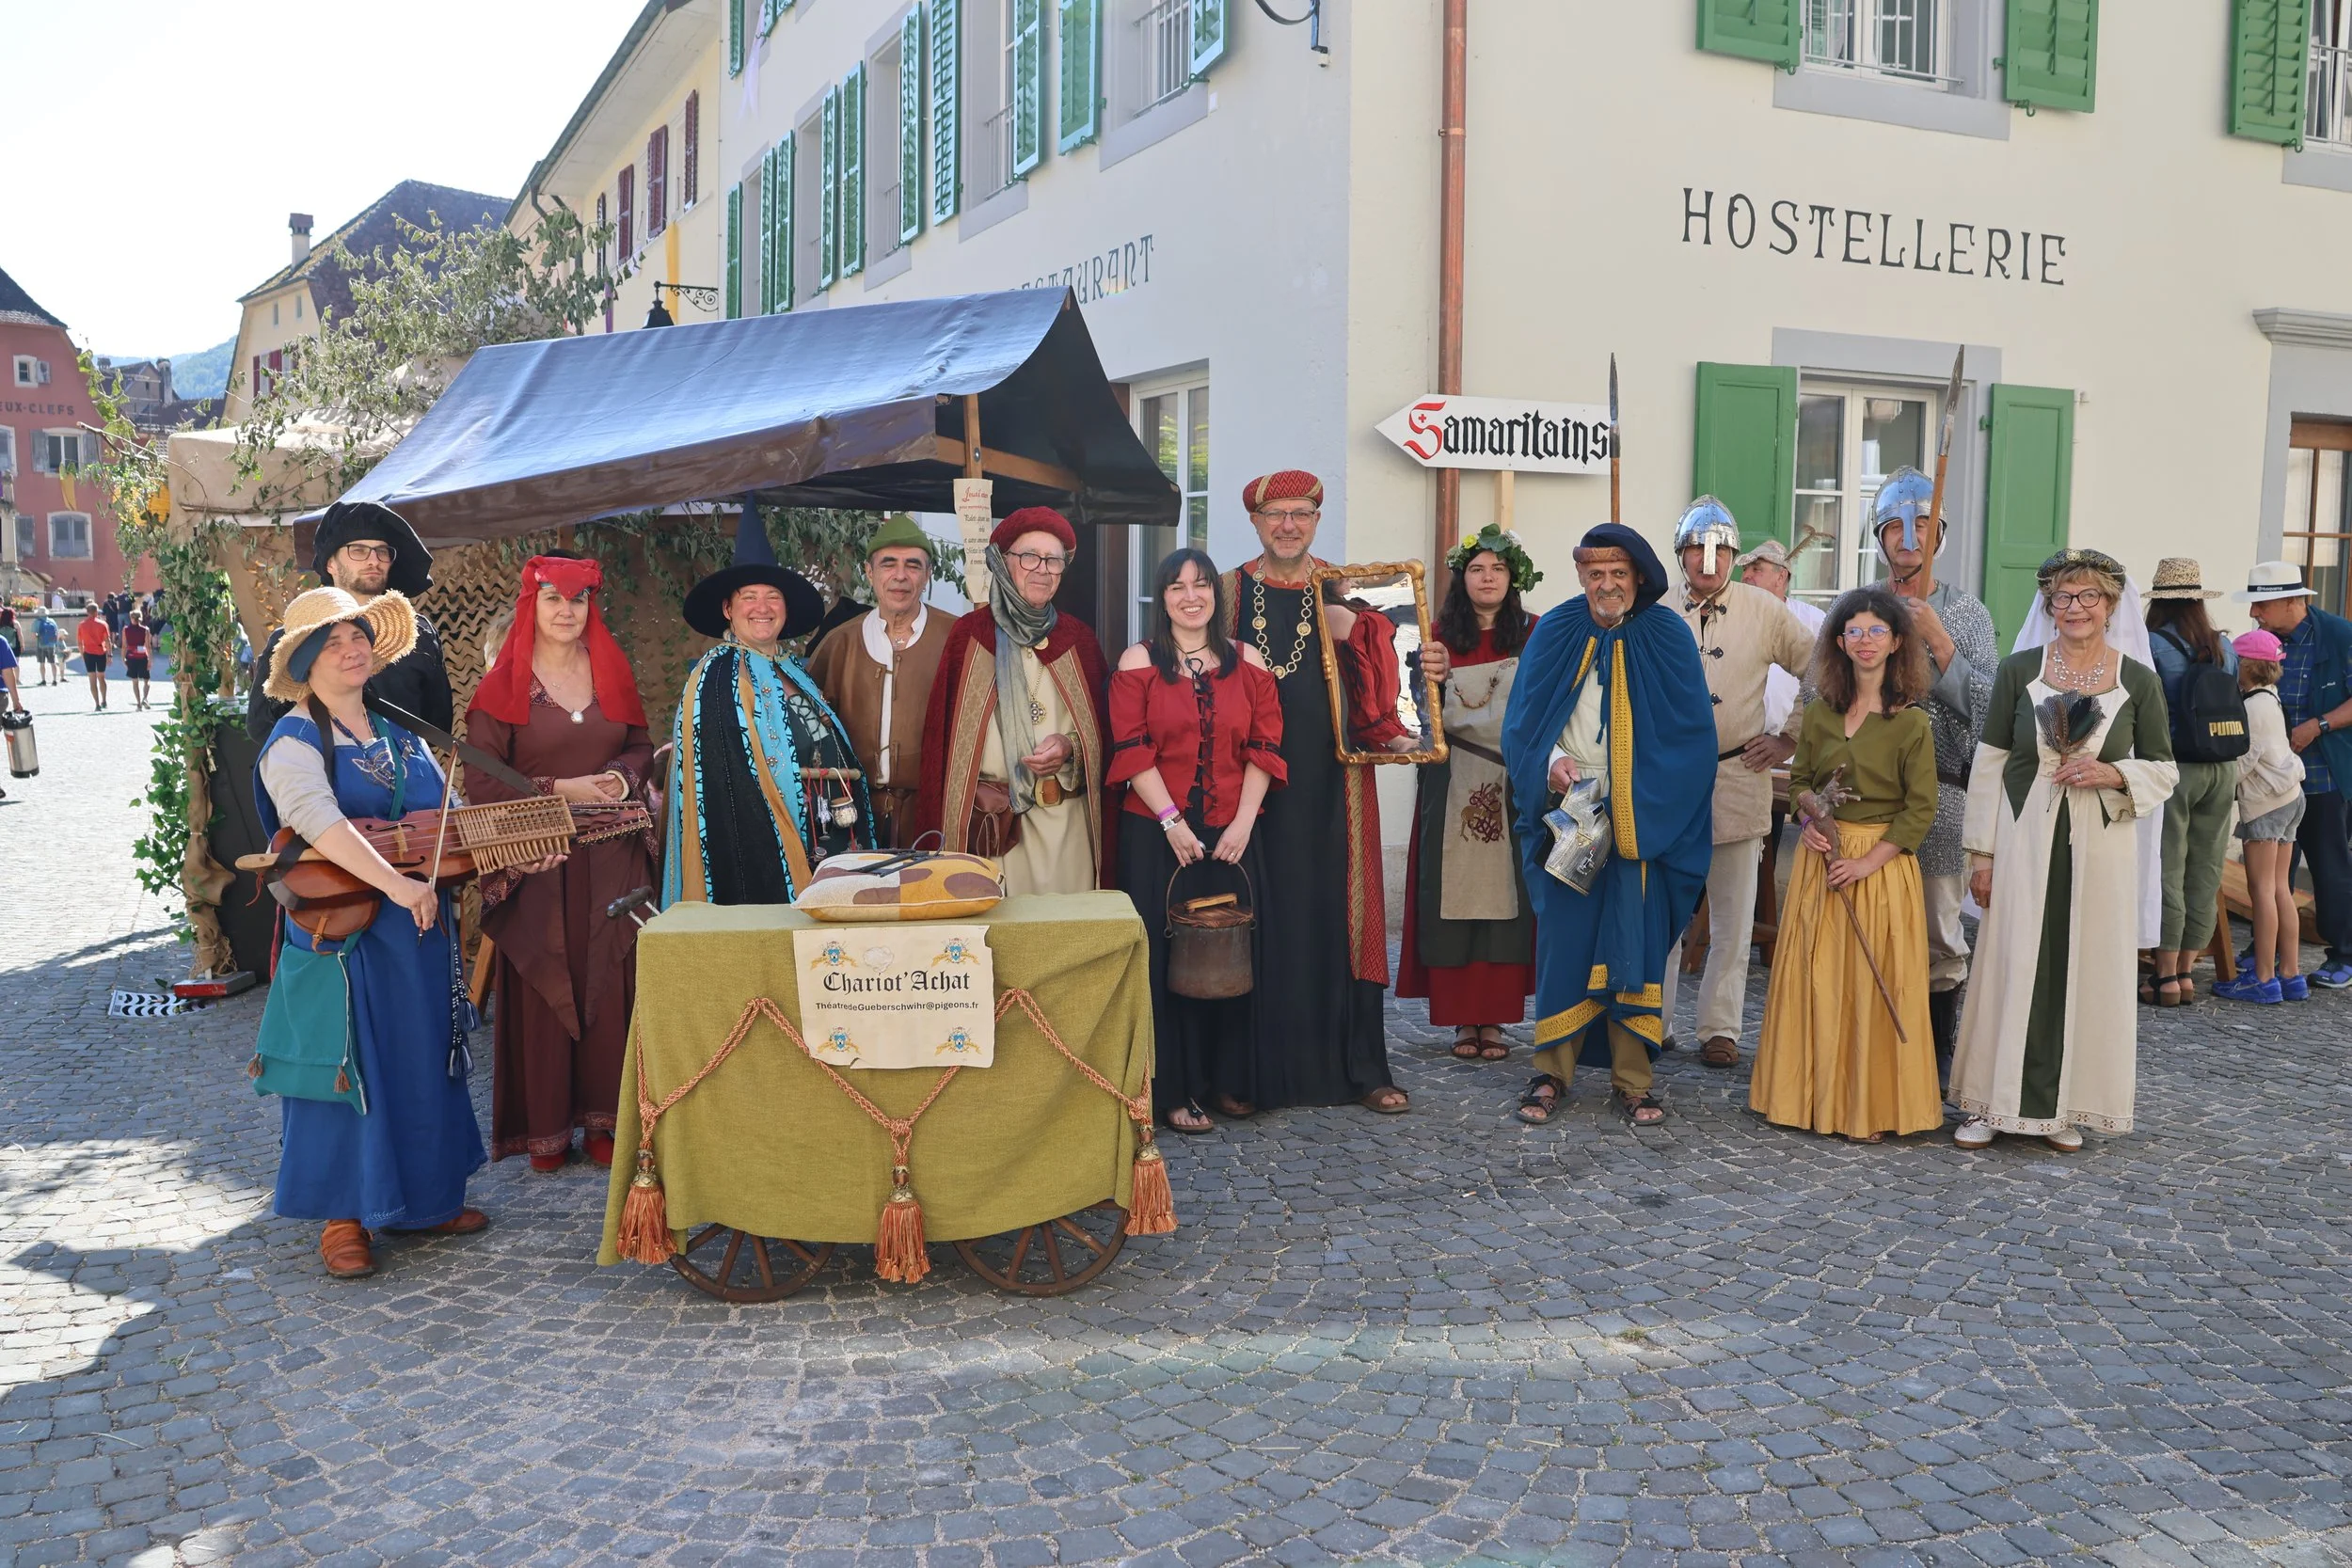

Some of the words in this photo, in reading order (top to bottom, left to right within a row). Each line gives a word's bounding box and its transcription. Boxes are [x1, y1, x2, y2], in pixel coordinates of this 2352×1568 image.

[1009, 234, 1153, 304] URANT
[1682, 187, 2066, 285] HOSTELLERIE
[1403, 401, 1610, 465] Samaritains
[2209, 721, 2245, 736] PUMA
